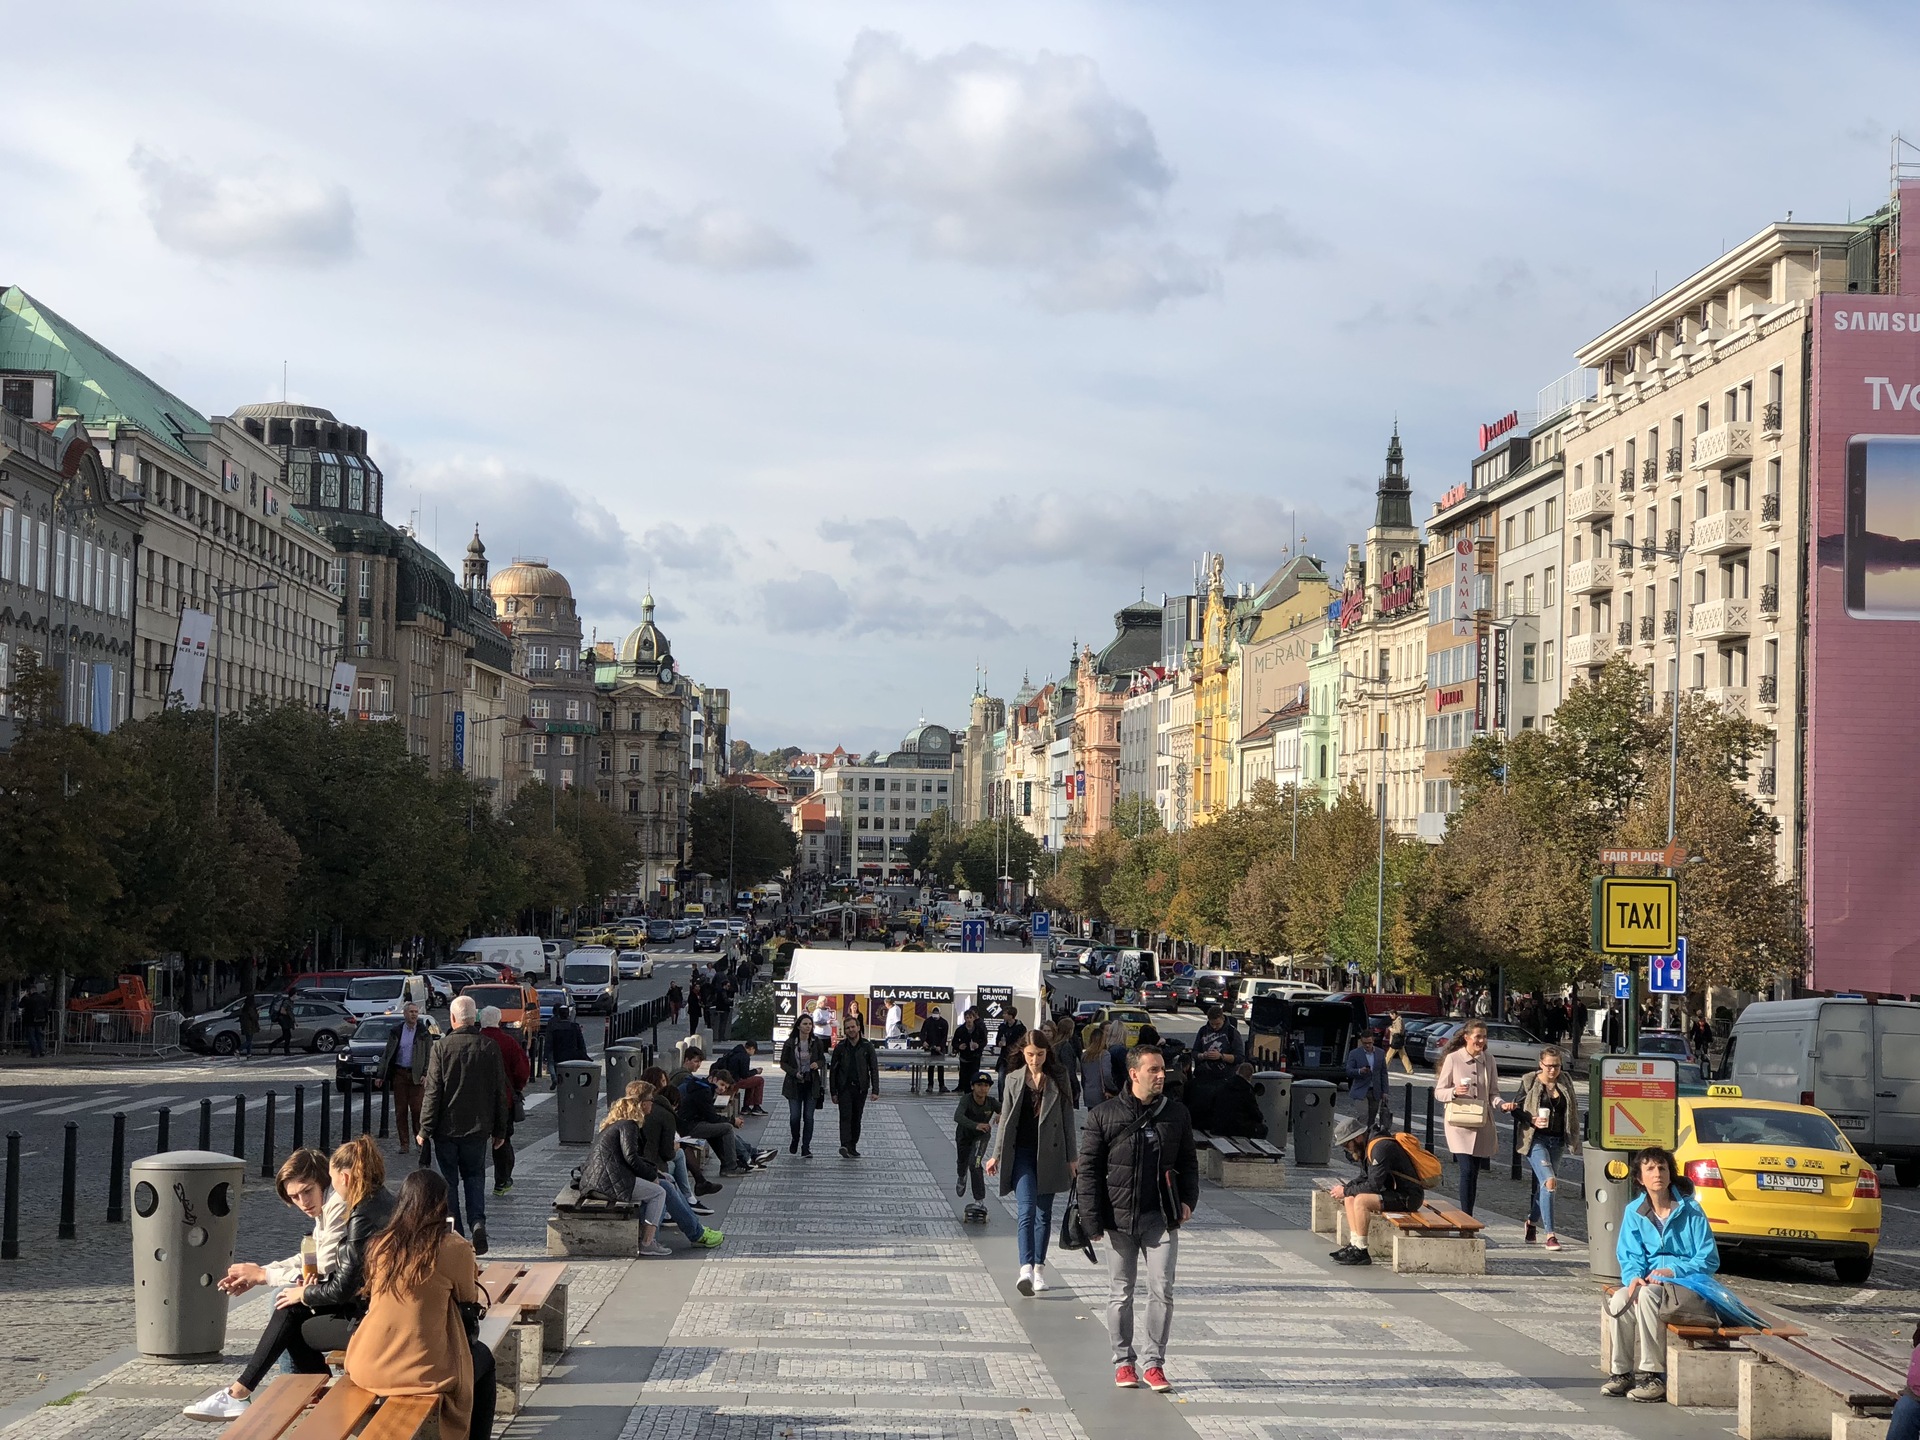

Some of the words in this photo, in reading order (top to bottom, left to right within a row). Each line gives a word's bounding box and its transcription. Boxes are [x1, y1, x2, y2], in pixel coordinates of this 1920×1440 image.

[1604, 301, 1710, 386] HOTEL
[1255, 640, 1305, 673] MERAN
[1479, 637, 1489, 683] Elysee
[1498, 632, 1506, 680] Elysee
[455, 715, 463, 765] ROKOK
[1603, 851, 1628, 862] FAIR
[1630, 851, 1665, 862] PLACE
[1035, 914, 1046, 930] P
[1616, 902, 1661, 930] TAXI
[1231, 961, 1237, 971] P
[1618, 976, 1629, 991] P
[873, 989, 896, 999] BÍLÁ
[898, 990, 951, 1000] PASTELKA
[1715, 1086, 1737, 1095] TAXI
[1759, 1157, 1780, 1165] AAA
[1803, 1160, 1824, 1169] AAA
[1766, 1174, 1785, 1186] 3AS
[1793, 1176, 1819, 1188] 0079
[1775, 1228, 1809, 1239] 14014
